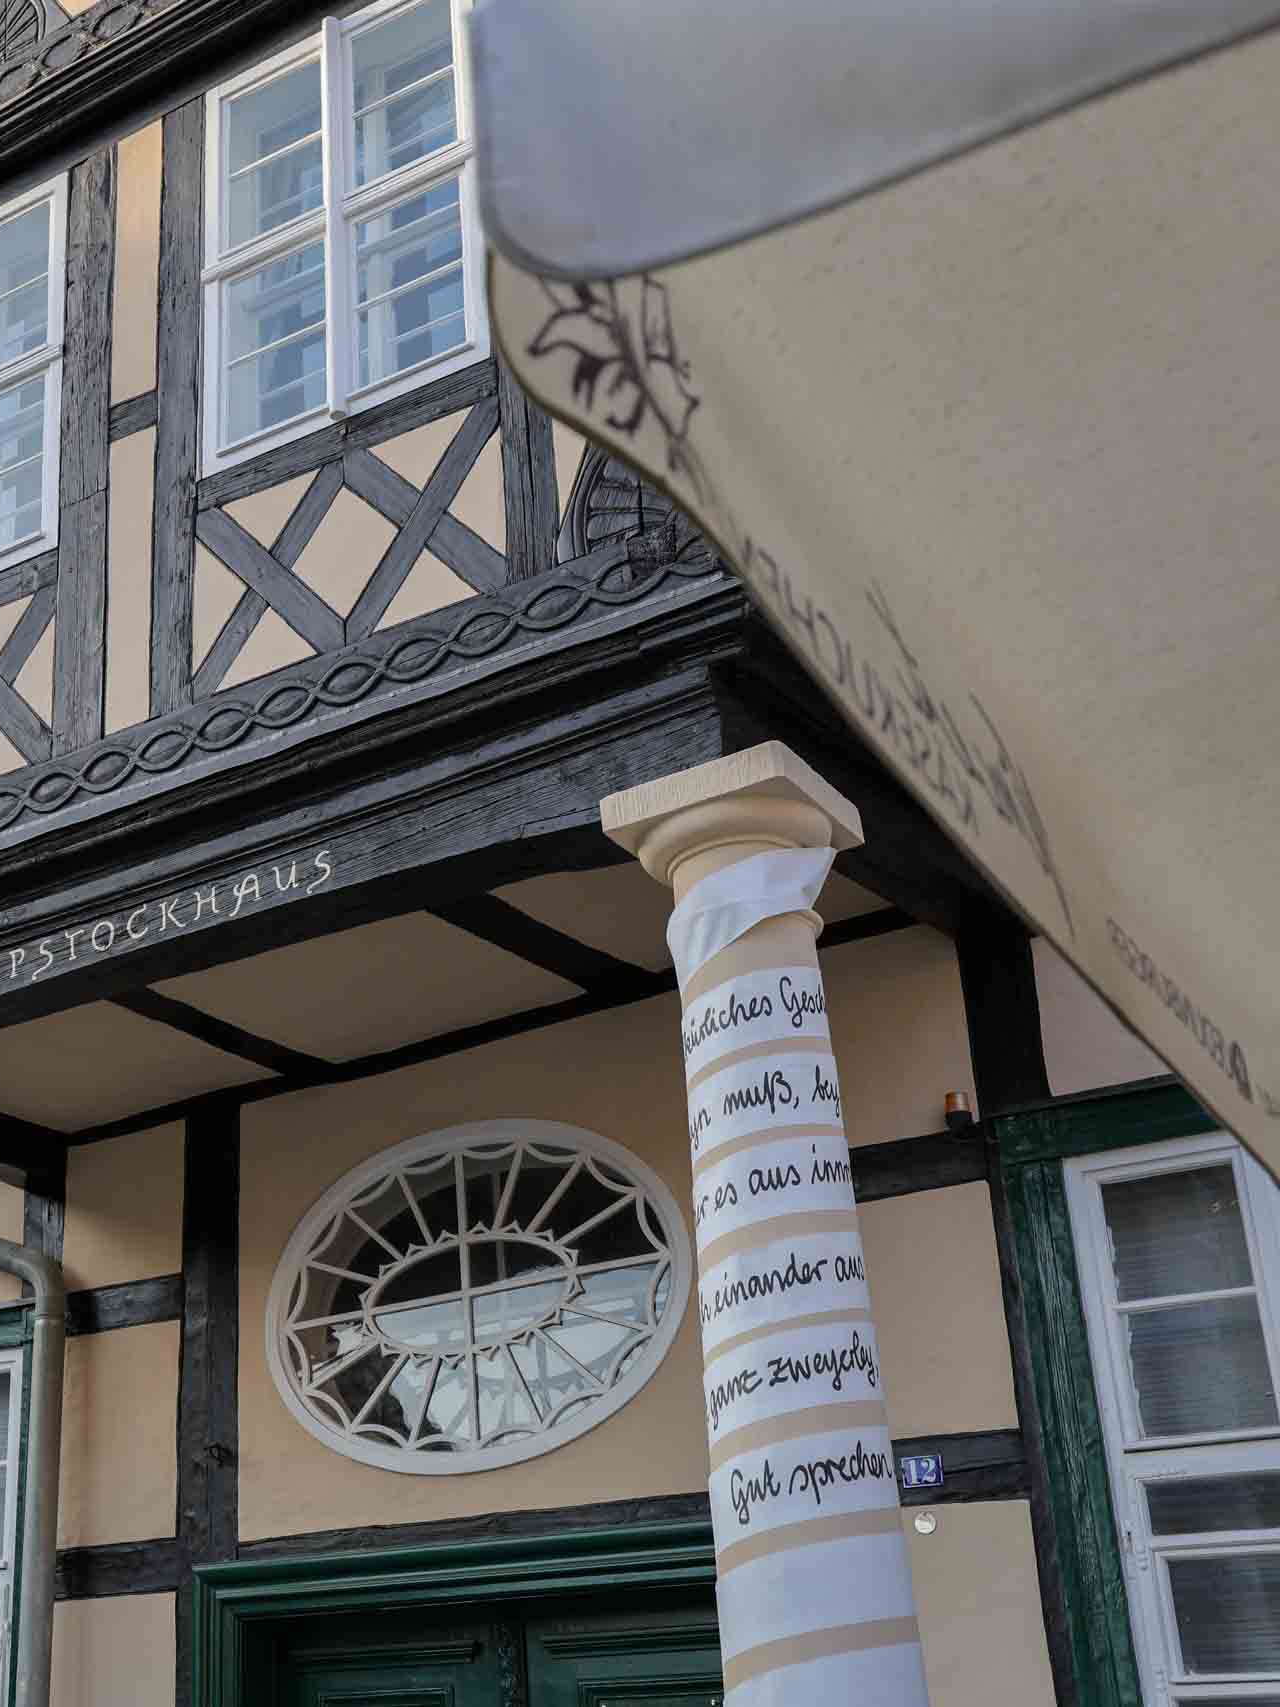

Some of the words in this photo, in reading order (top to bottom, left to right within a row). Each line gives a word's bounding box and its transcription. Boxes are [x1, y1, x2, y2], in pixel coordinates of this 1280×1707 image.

[723, 1070, 799, 1116] muß,
[714, 1182, 739, 1213] es
[748, 1164, 801, 1196] aus
[713, 1252, 829, 1318] einander
[730, 1458, 781, 1525] Gut
[788, 1439, 894, 1505] sprechen
[907, 1457, 938, 1486] 12
